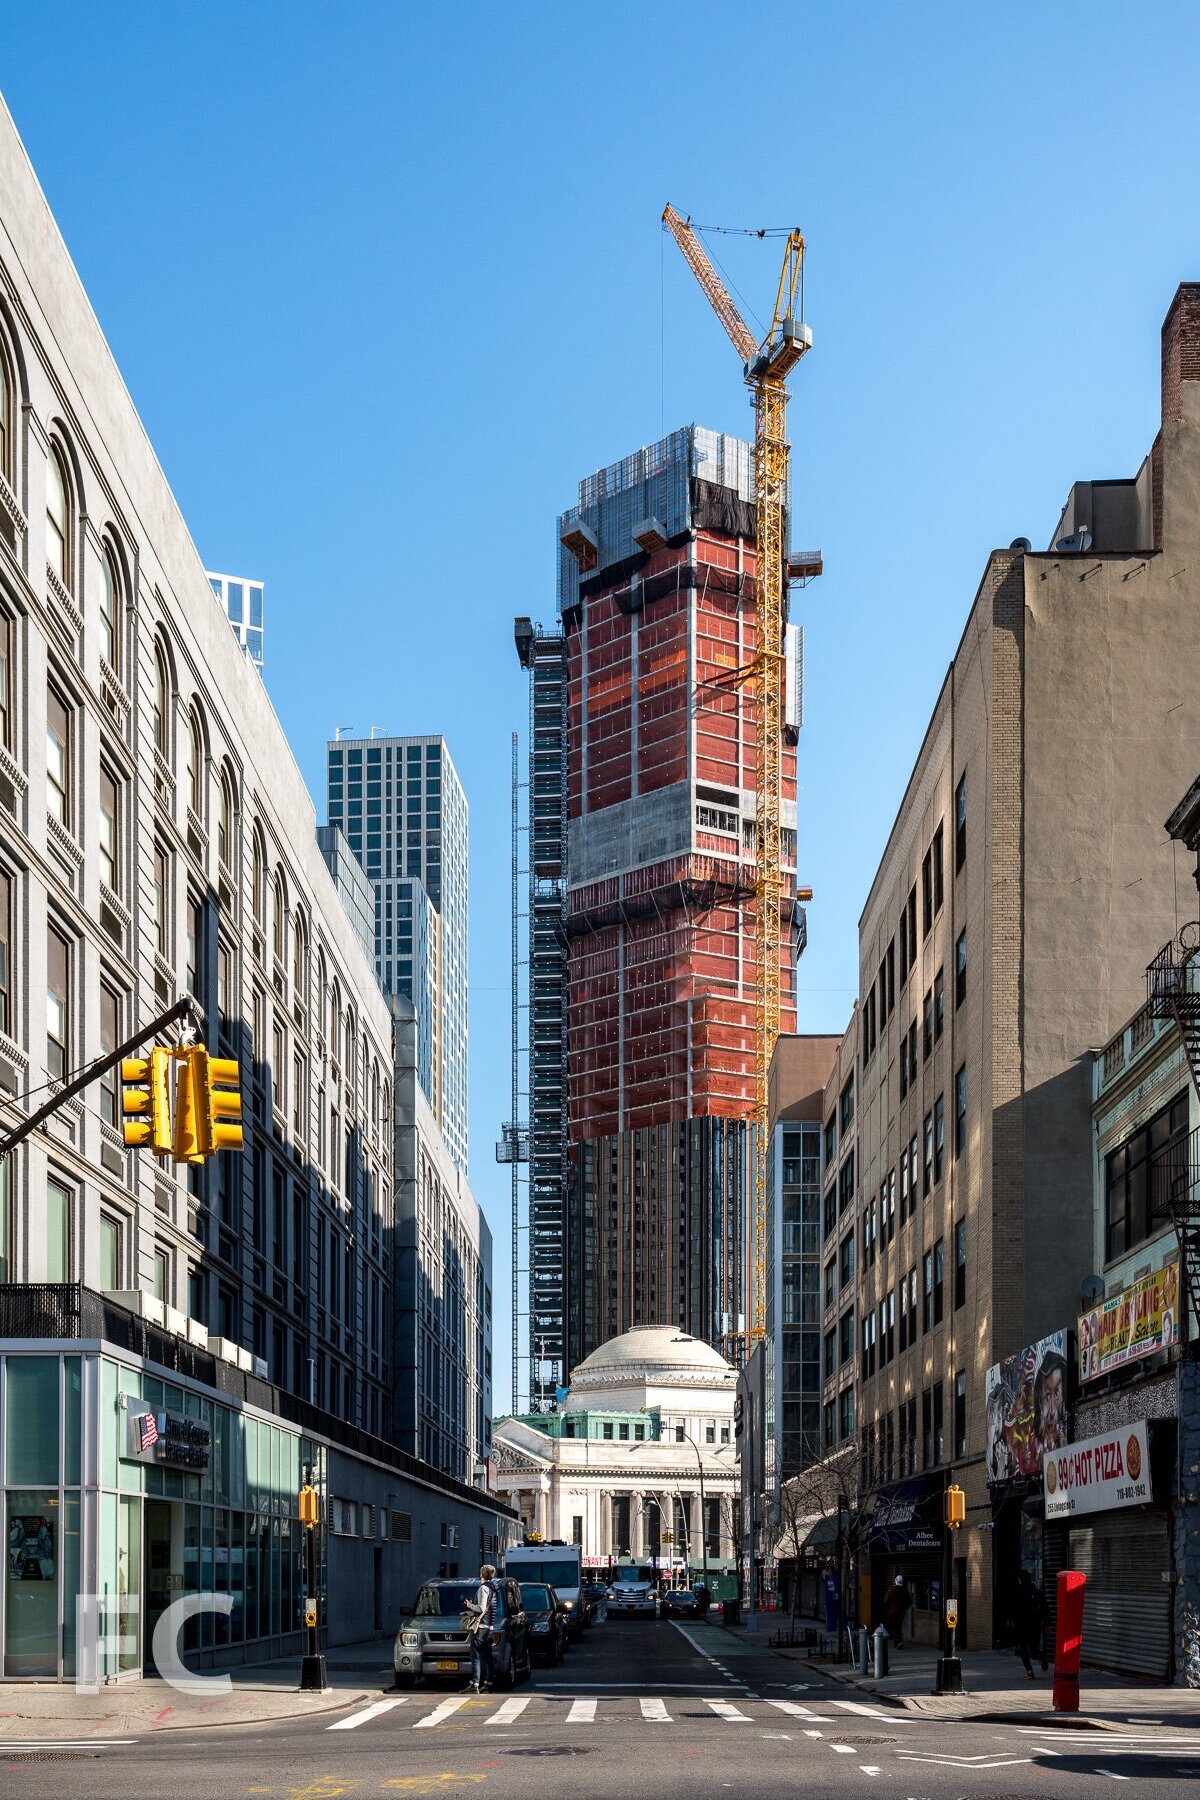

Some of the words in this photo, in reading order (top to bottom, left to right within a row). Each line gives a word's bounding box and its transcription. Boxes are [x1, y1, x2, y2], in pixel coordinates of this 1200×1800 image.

[1098, 1309, 1117, 1341] HAIR
[1074, 1450, 1092, 1487] HOT
[1094, 1440, 1124, 1483] PIZZA
[907, 1539, 941, 1547] Dentalcare
[915, 1531, 934, 1539] Albee
